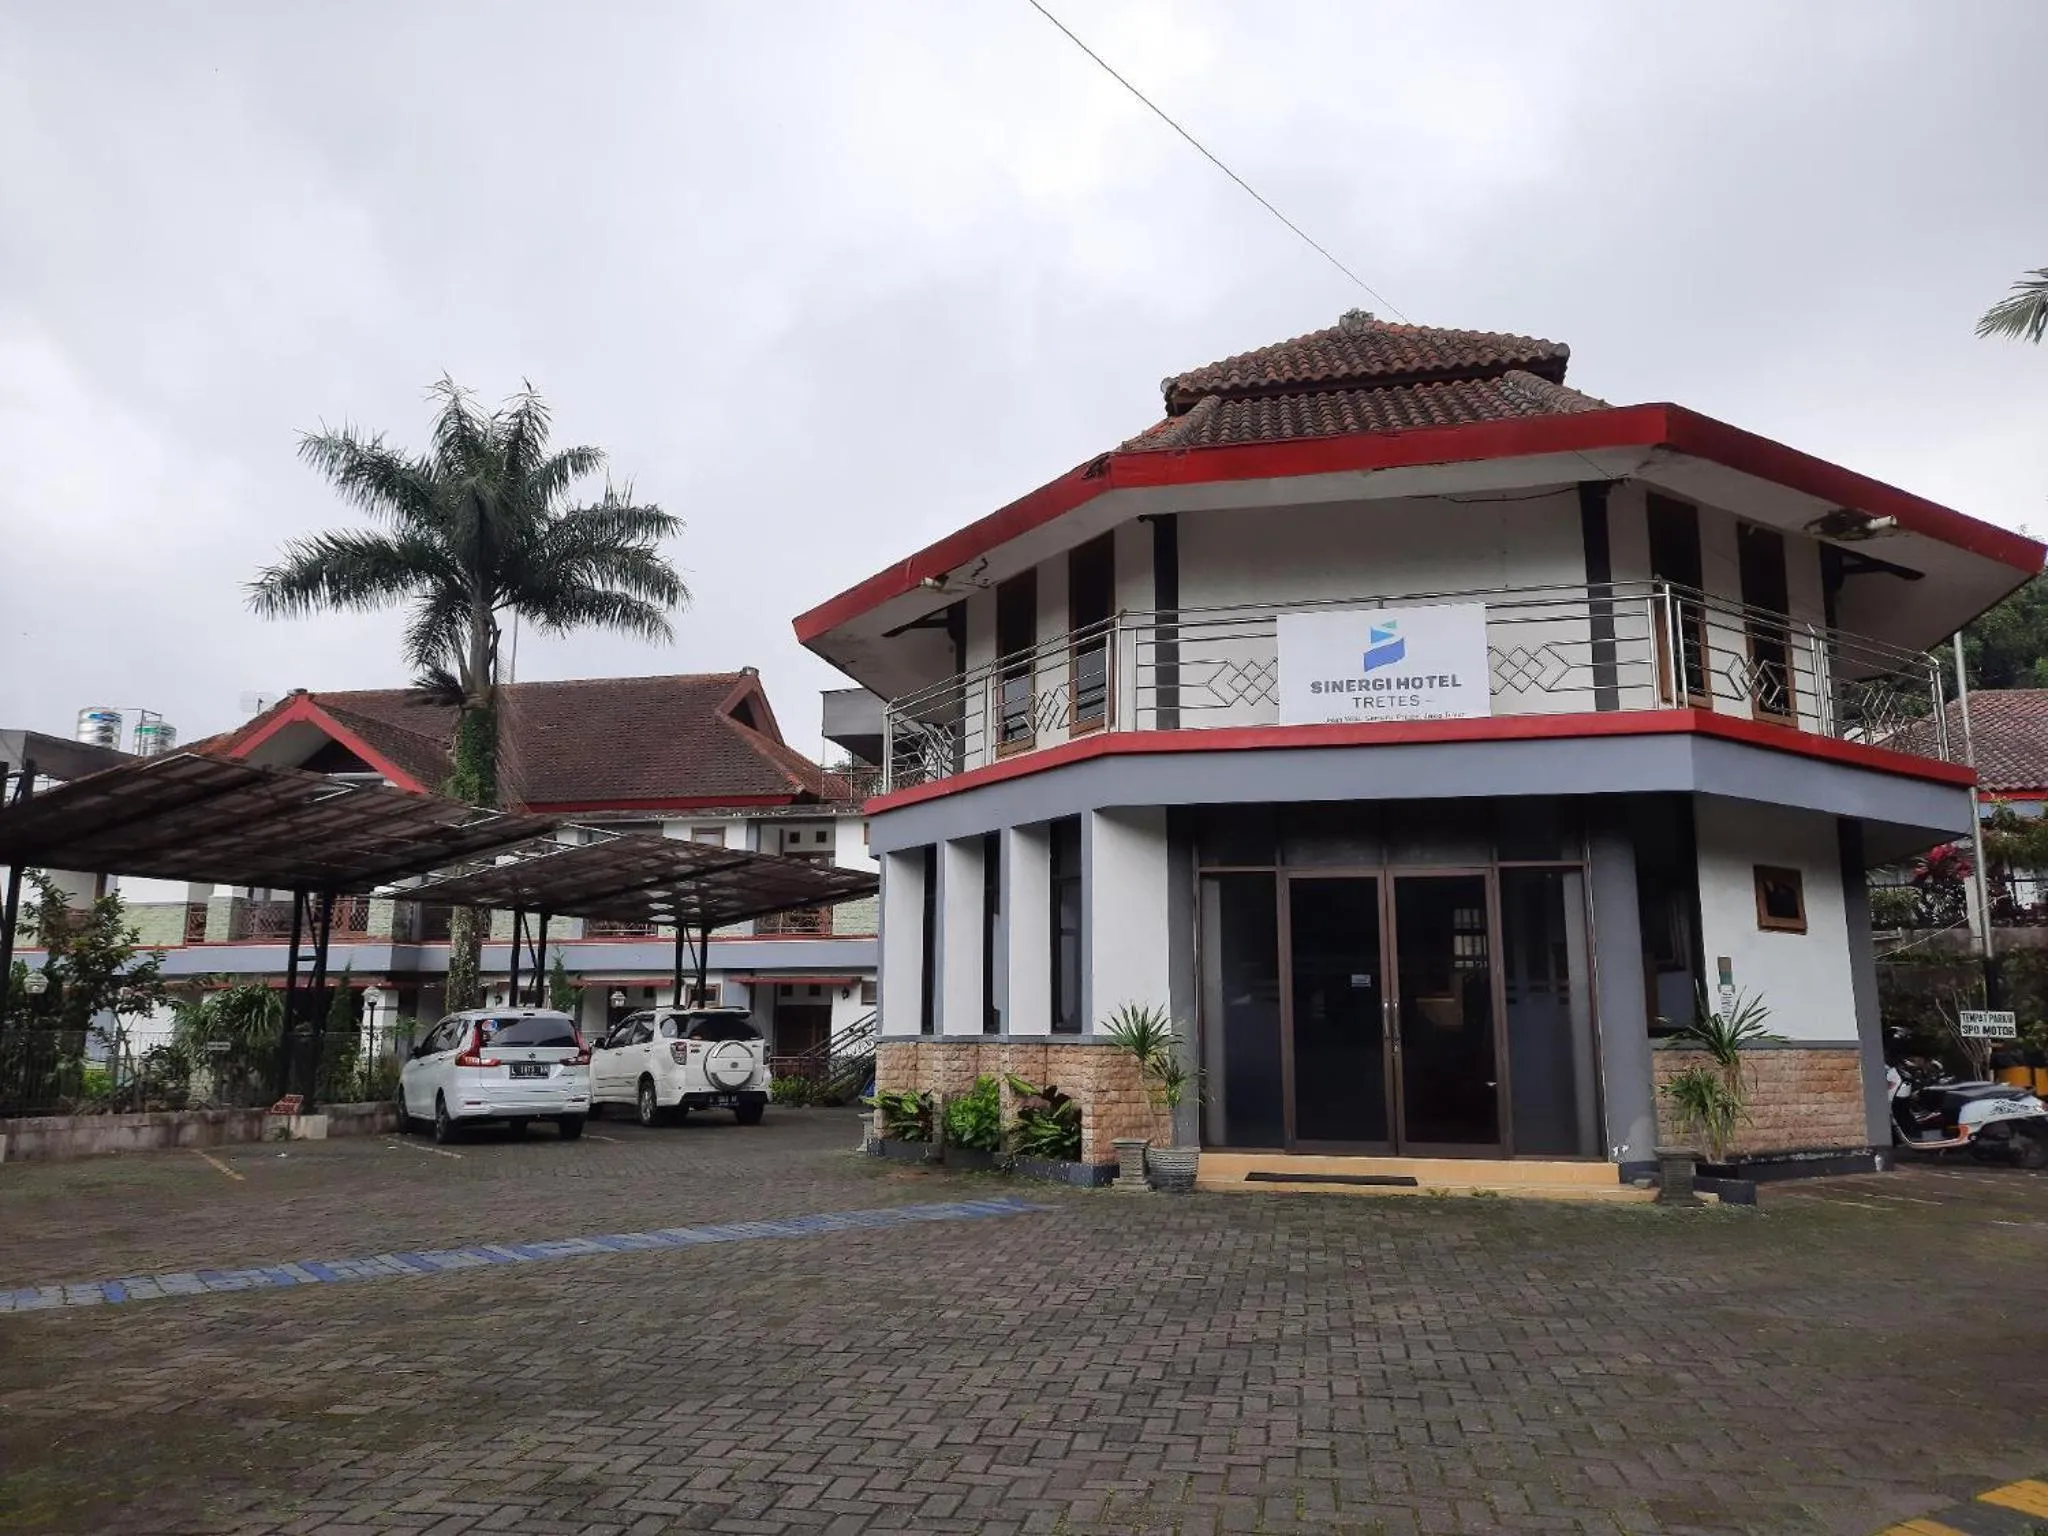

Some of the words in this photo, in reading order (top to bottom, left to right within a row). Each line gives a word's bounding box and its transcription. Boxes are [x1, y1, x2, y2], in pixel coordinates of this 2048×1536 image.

[1310, 678, 1391, 694] SINERGI
[1396, 674, 1462, 690] HOTEL
[1352, 695, 1420, 709] TRETES
[1962, 1013, 1987, 1023] TEMPAT
[1983, 1026, 2015, 1036] MOTOR
